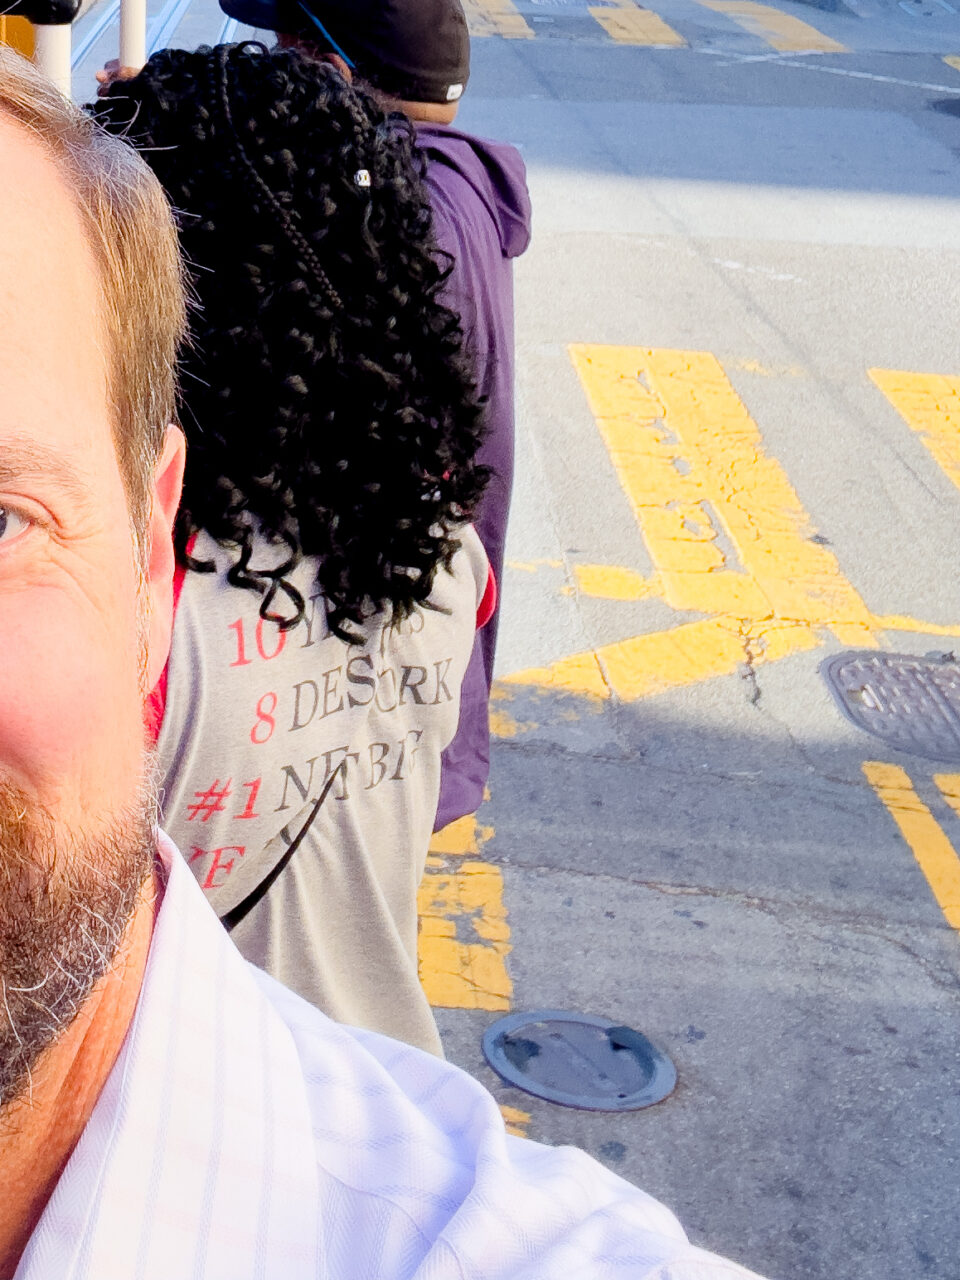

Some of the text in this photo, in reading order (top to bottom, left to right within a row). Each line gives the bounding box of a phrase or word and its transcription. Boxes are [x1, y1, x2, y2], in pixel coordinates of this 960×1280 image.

[227, 611, 287, 667] 10
[250, 691, 278, 744] 8
[187, 777, 262, 822] #1
